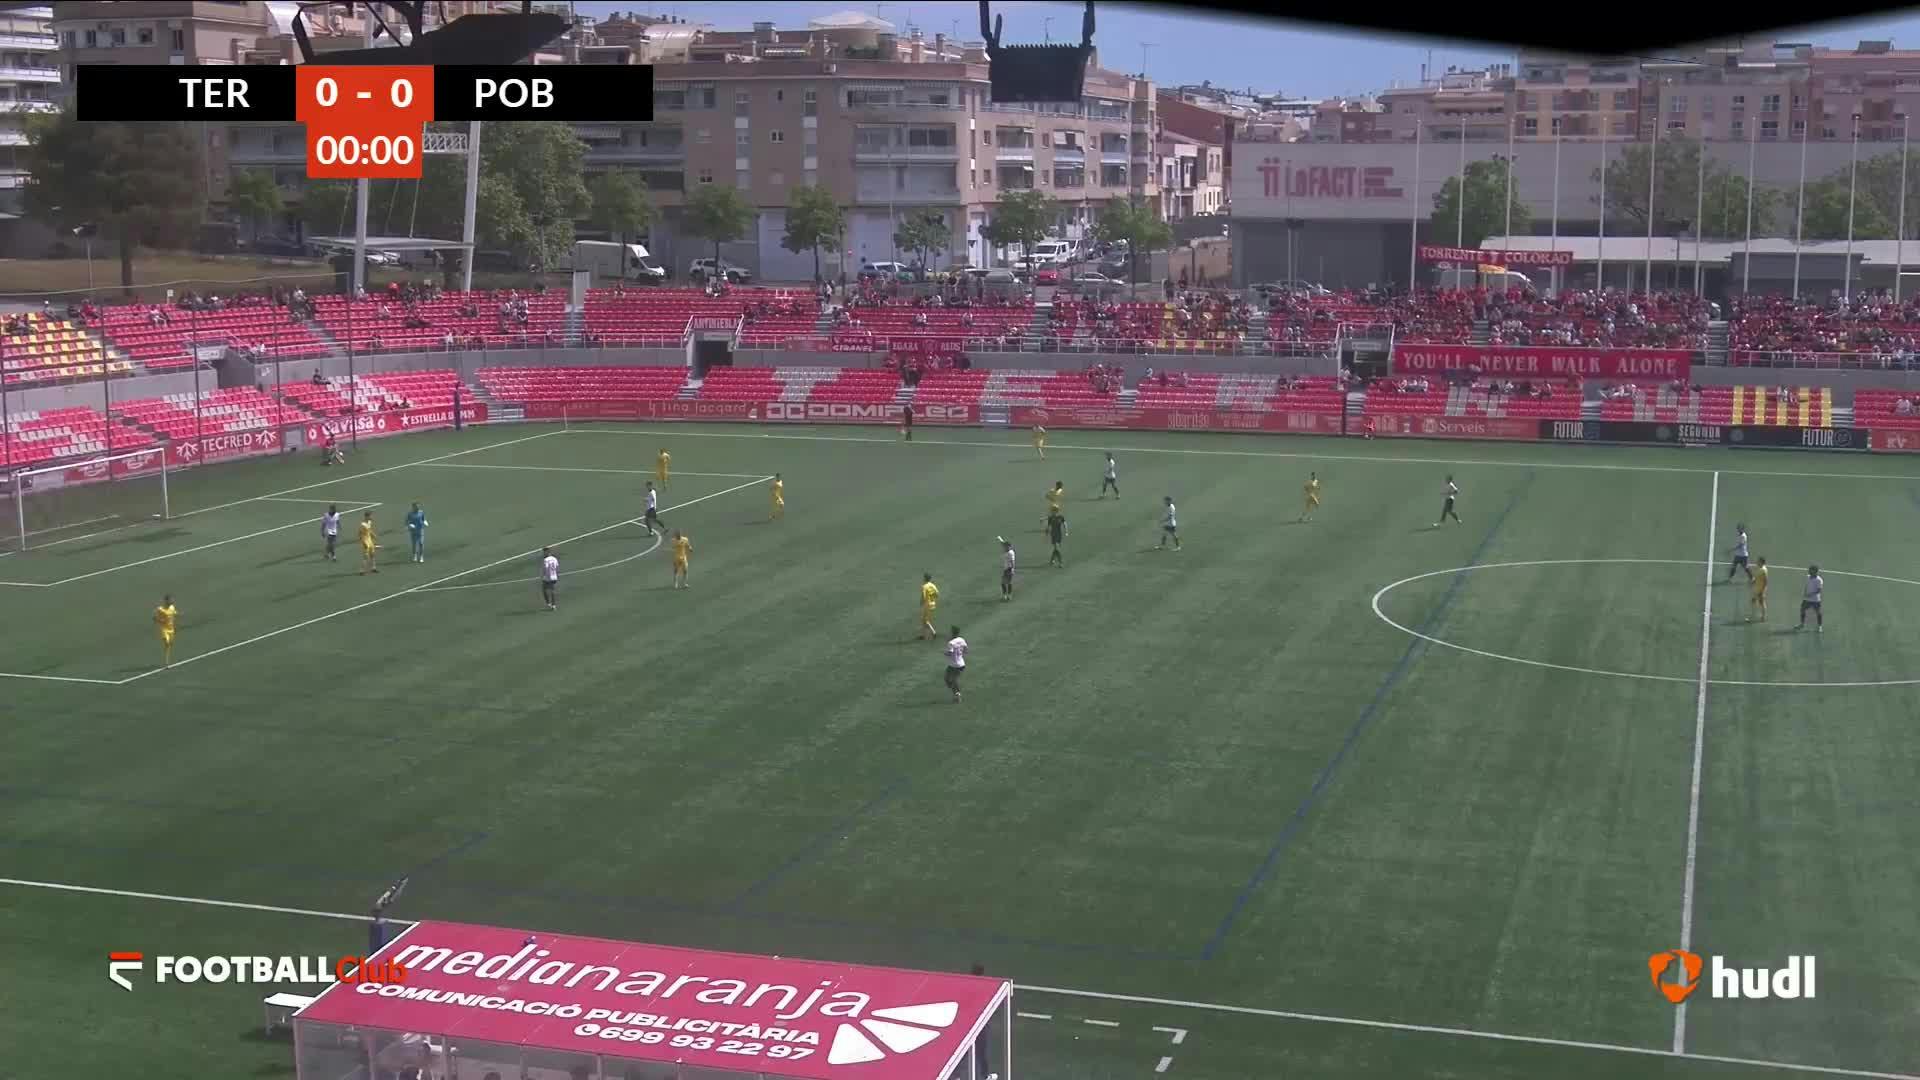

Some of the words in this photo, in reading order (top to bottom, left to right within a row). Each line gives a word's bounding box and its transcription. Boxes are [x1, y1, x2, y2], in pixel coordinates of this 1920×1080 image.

[1403, 352, 1465, 369] YOU'LL
[1479, 355, 1539, 372] NEVER
[1551, 356, 1601, 374] WALK
[1616, 357, 1678, 374] ALONE
[410, 411, 447, 425] ESTRELLA
[1439, 419, 1486, 433] Serveis
[1553, 421, 1584, 439] FUTUR
[1802, 429, 1834, 446] FUTUR
[201, 432, 253, 452] TECFRED
[394, 943, 871, 1019] medianaranja
[356, 981, 583, 1019] COMUNICACIÓ
[583, 1008, 819, 1046] PUBLICITÀRIA
[598, 1025, 665, 1045] 699
[668, 1033, 713, 1051] 93
[715, 1039, 764, 1058] 22
[765, 1045, 816, 1061] 97
